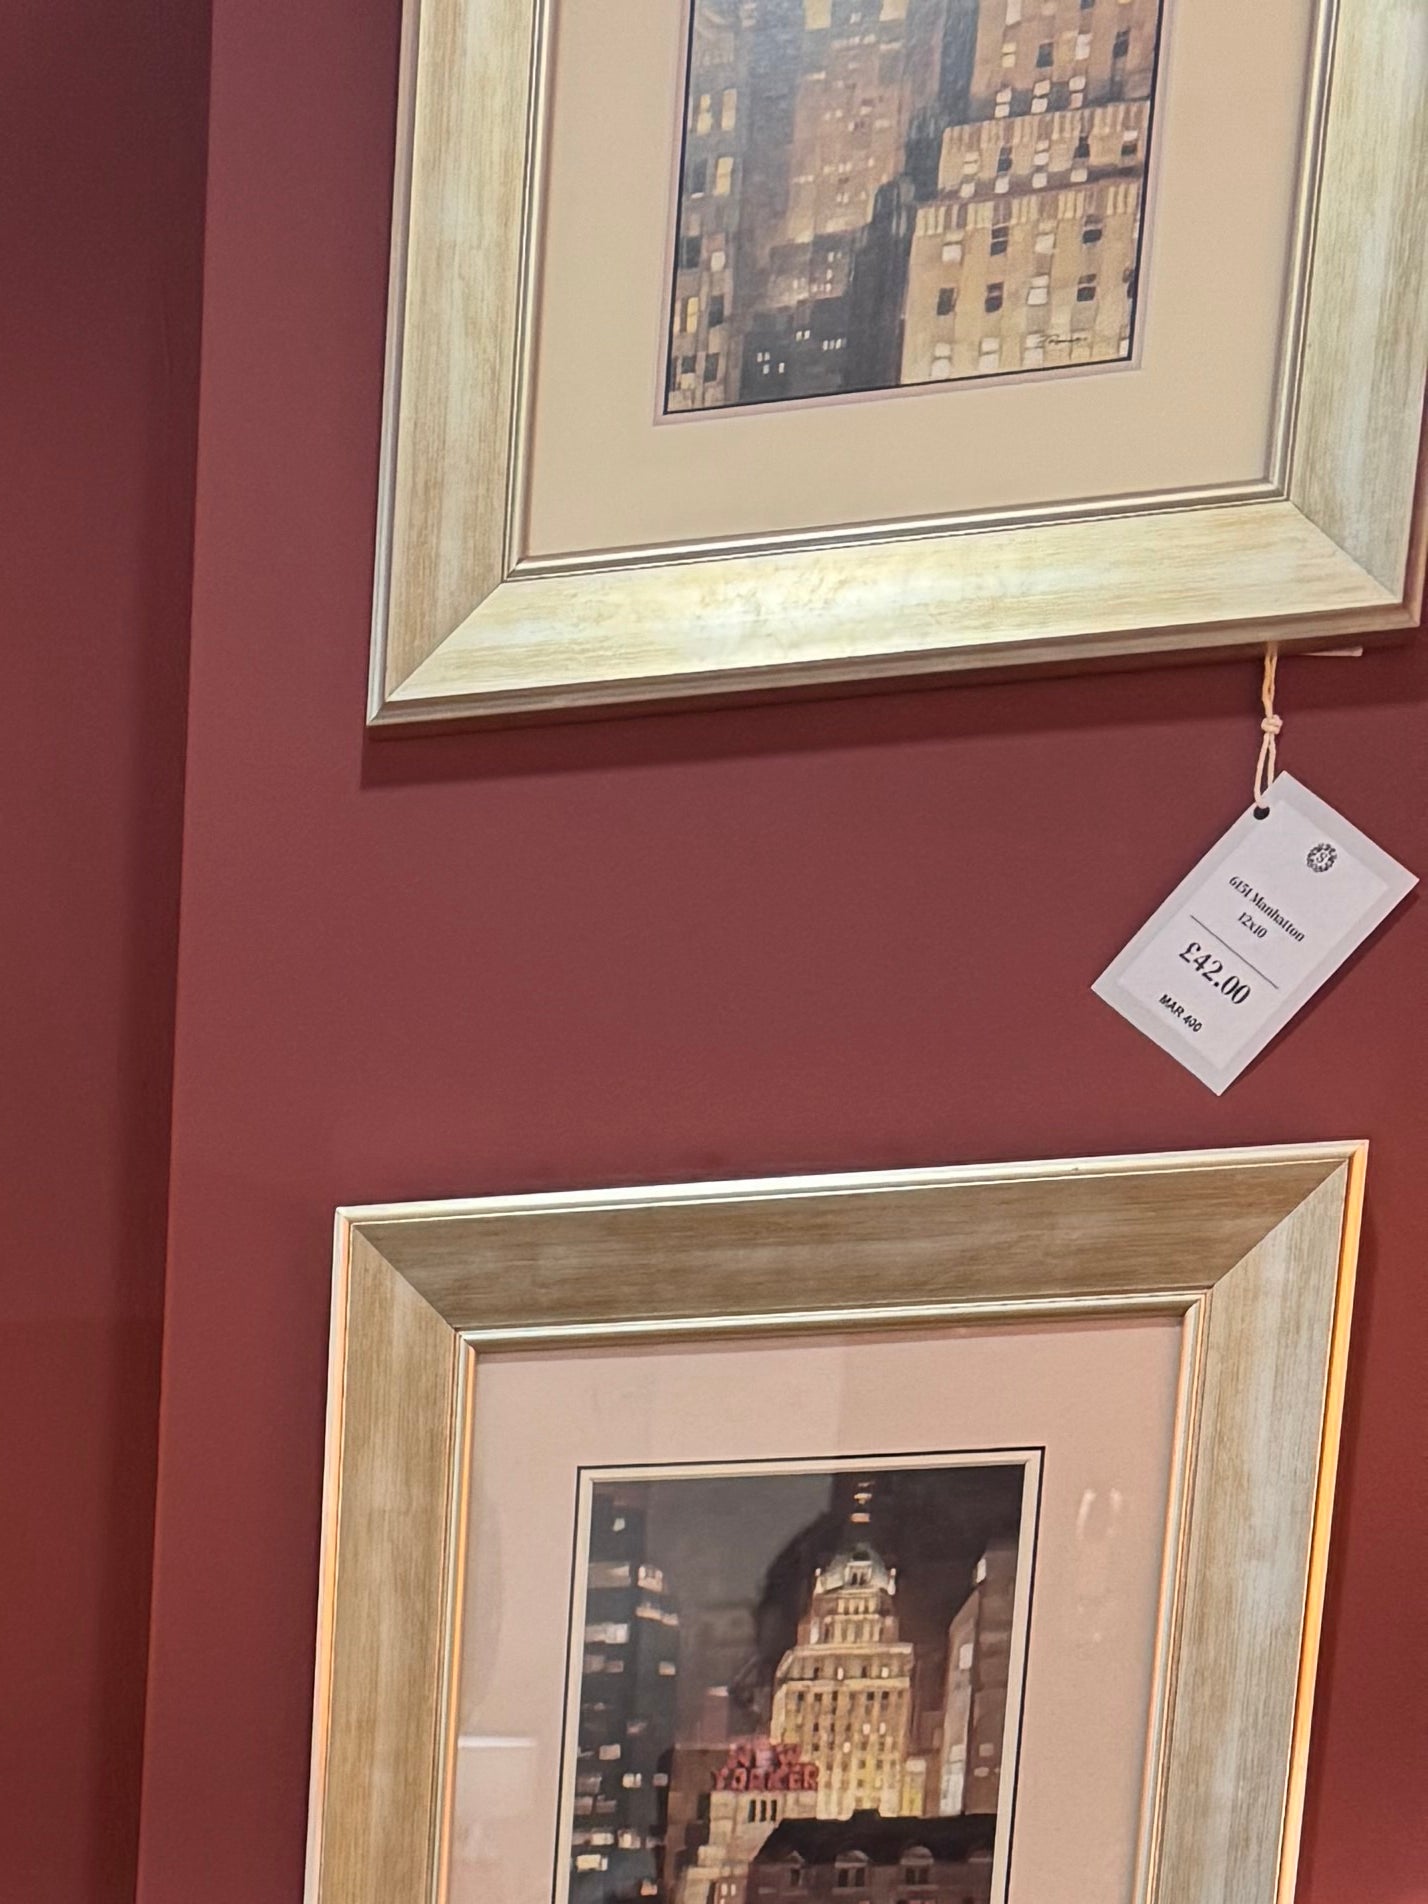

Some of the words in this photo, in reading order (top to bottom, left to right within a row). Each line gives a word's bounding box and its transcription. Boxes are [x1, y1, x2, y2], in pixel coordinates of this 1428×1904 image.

[1229, 876, 1254, 898] 6151
[1251, 892, 1306, 943] Manhatton
[1237, 912, 1269, 939] 12x10
[1179, 942, 1252, 1005] £42.00
[1159, 994, 1185, 1018] MAR
[1183, 1015, 1203, 1033] 400
